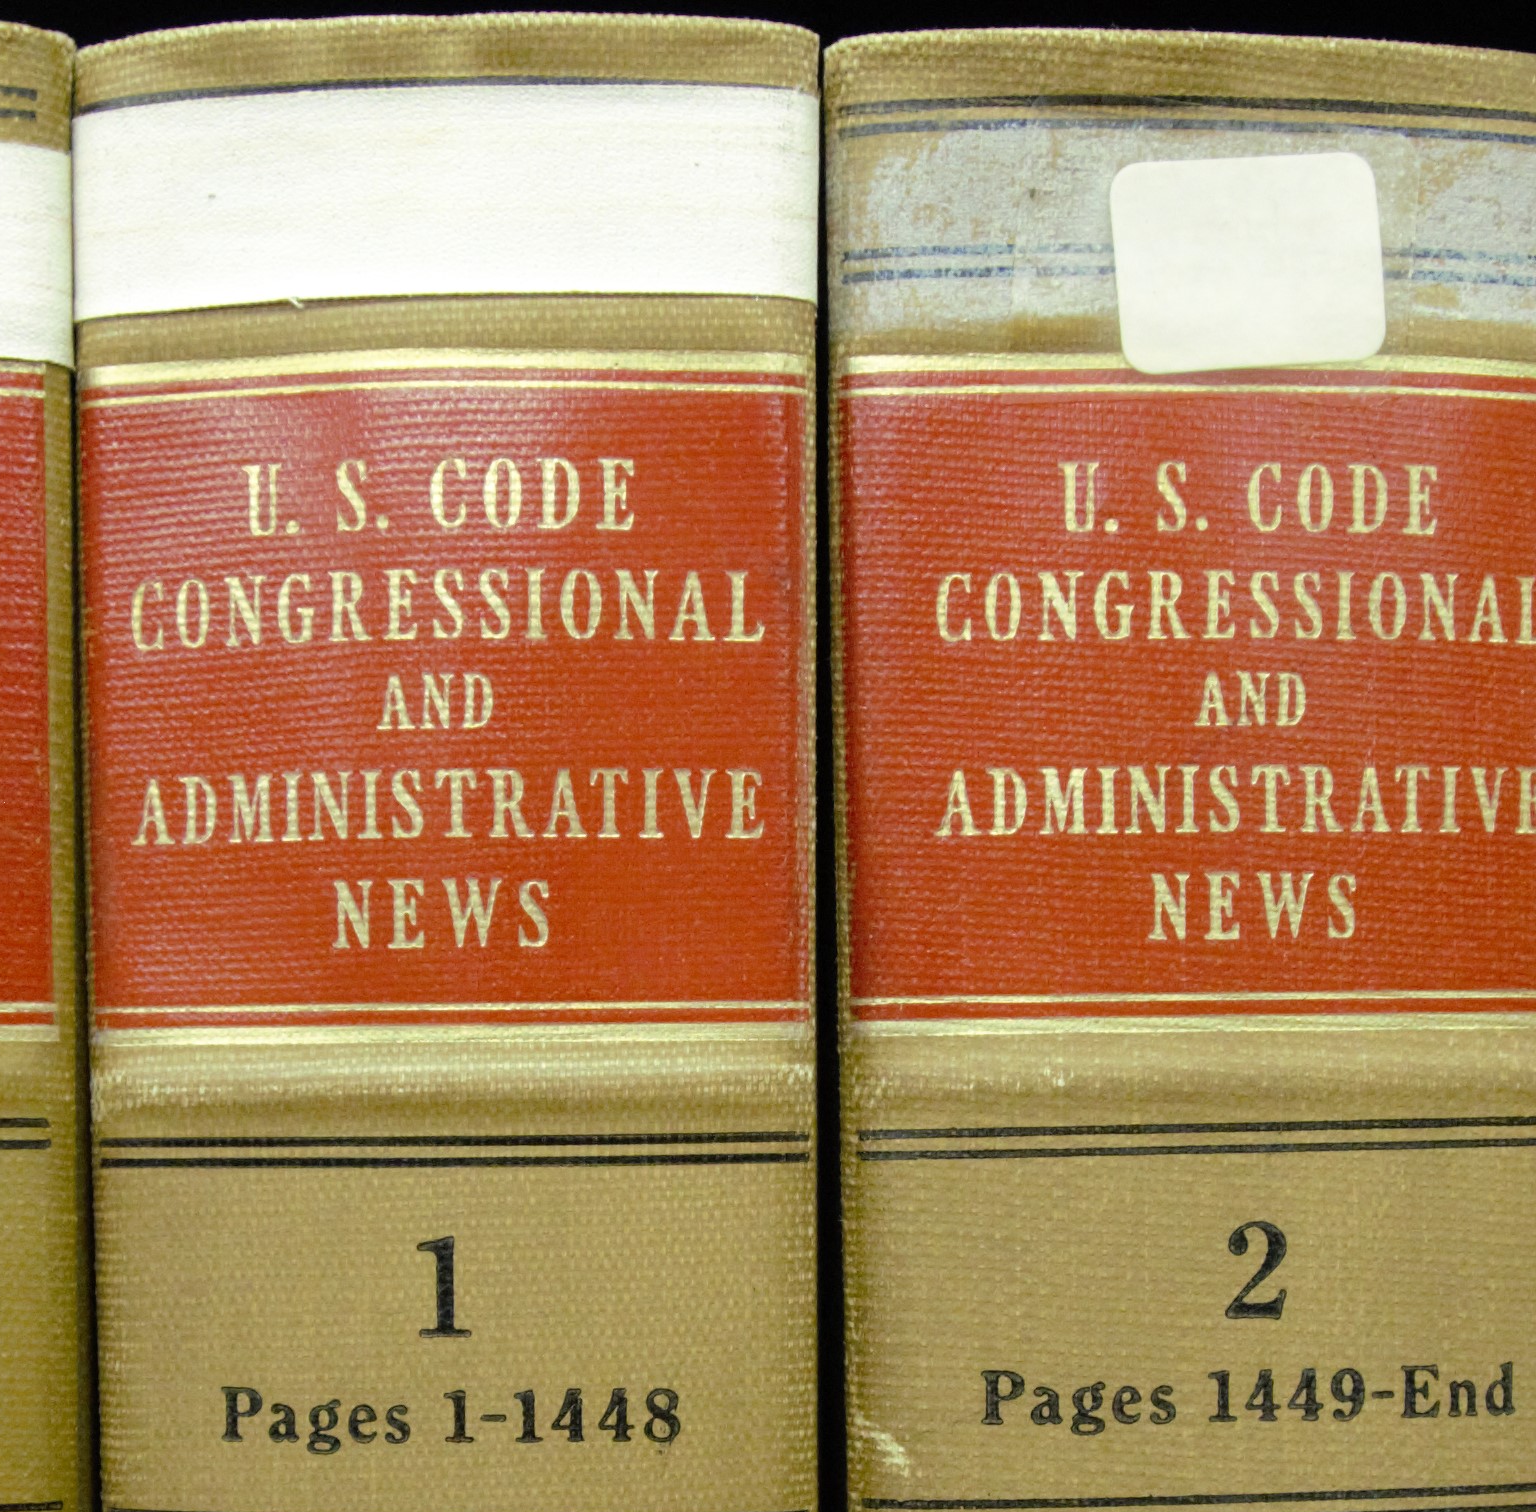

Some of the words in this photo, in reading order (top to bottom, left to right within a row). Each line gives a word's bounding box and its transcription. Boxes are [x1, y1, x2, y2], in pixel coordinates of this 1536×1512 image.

[242, 463, 301, 537] U.
[335, 457, 390, 533] S.
[428, 456, 636, 532] CODE
[1058, 460, 1119, 535] U.
[1155, 460, 1209, 534] S.
[1247, 462, 1438, 536] CODE
[130, 567, 766, 652] CONGRESSIONAL
[376, 672, 494, 730] AND
[1194, 671, 1307, 728] AND
[131, 767, 764, 846] ADMINISTRATIVE
[331, 878, 550, 950] NEWS
[1148, 870, 1357, 941] NEWS
[416, 1236, 473, 1339] 1
[1224, 1220, 1288, 1321] 2
[220, 1386, 410, 1455] Pages
[444, 1387, 682, 1444] 1-1448
[980, 1369, 1176, 1437] Pages
[1207, 1361, 1517, 1424] 1449-End
